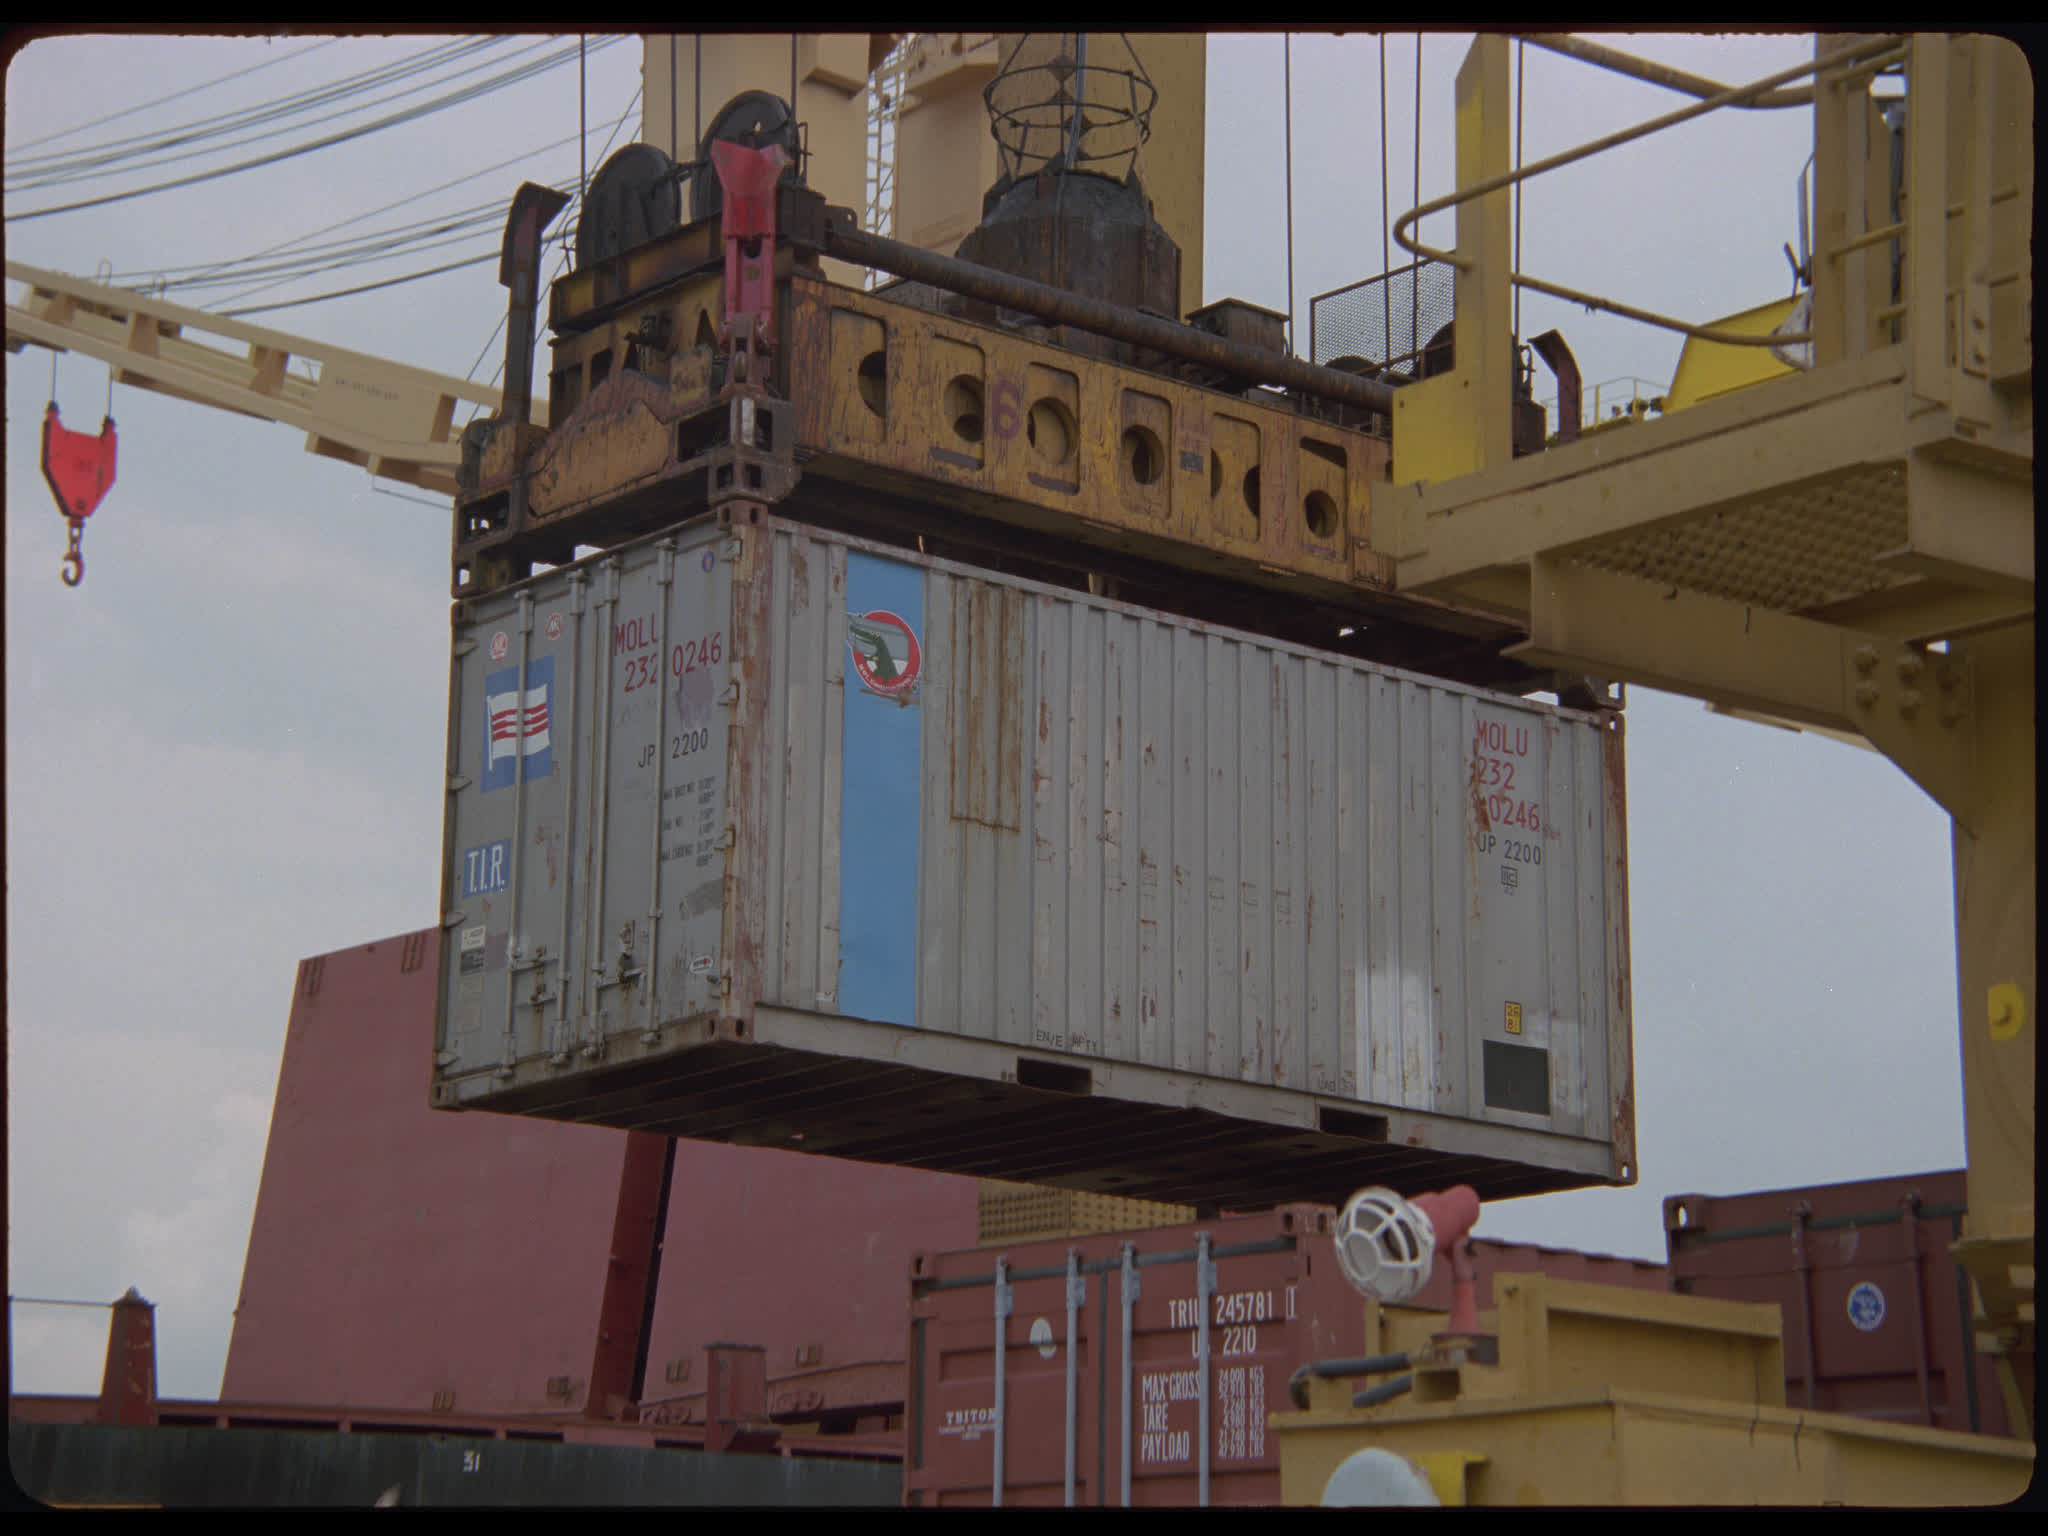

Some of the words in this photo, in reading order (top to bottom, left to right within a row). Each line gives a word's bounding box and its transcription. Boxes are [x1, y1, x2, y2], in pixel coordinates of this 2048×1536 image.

[672, 631, 722, 677] 0246
[638, 743, 656, 769] JP
[671, 727, 709, 760] 2200
[1476, 719, 1528, 757] MOLU
[1477, 755, 1516, 790] 232
[1488, 794, 1541, 831] 0246
[1478, 833, 1497, 854] JP
[1503, 839, 1542, 865] 2200
[1215, 1289, 1273, 1326] 245781
[1223, 1324, 1257, 1357] 2210
[1143, 1401, 1168, 1433] TARE
[1141, 1429, 1190, 1464] PAYLOAD
